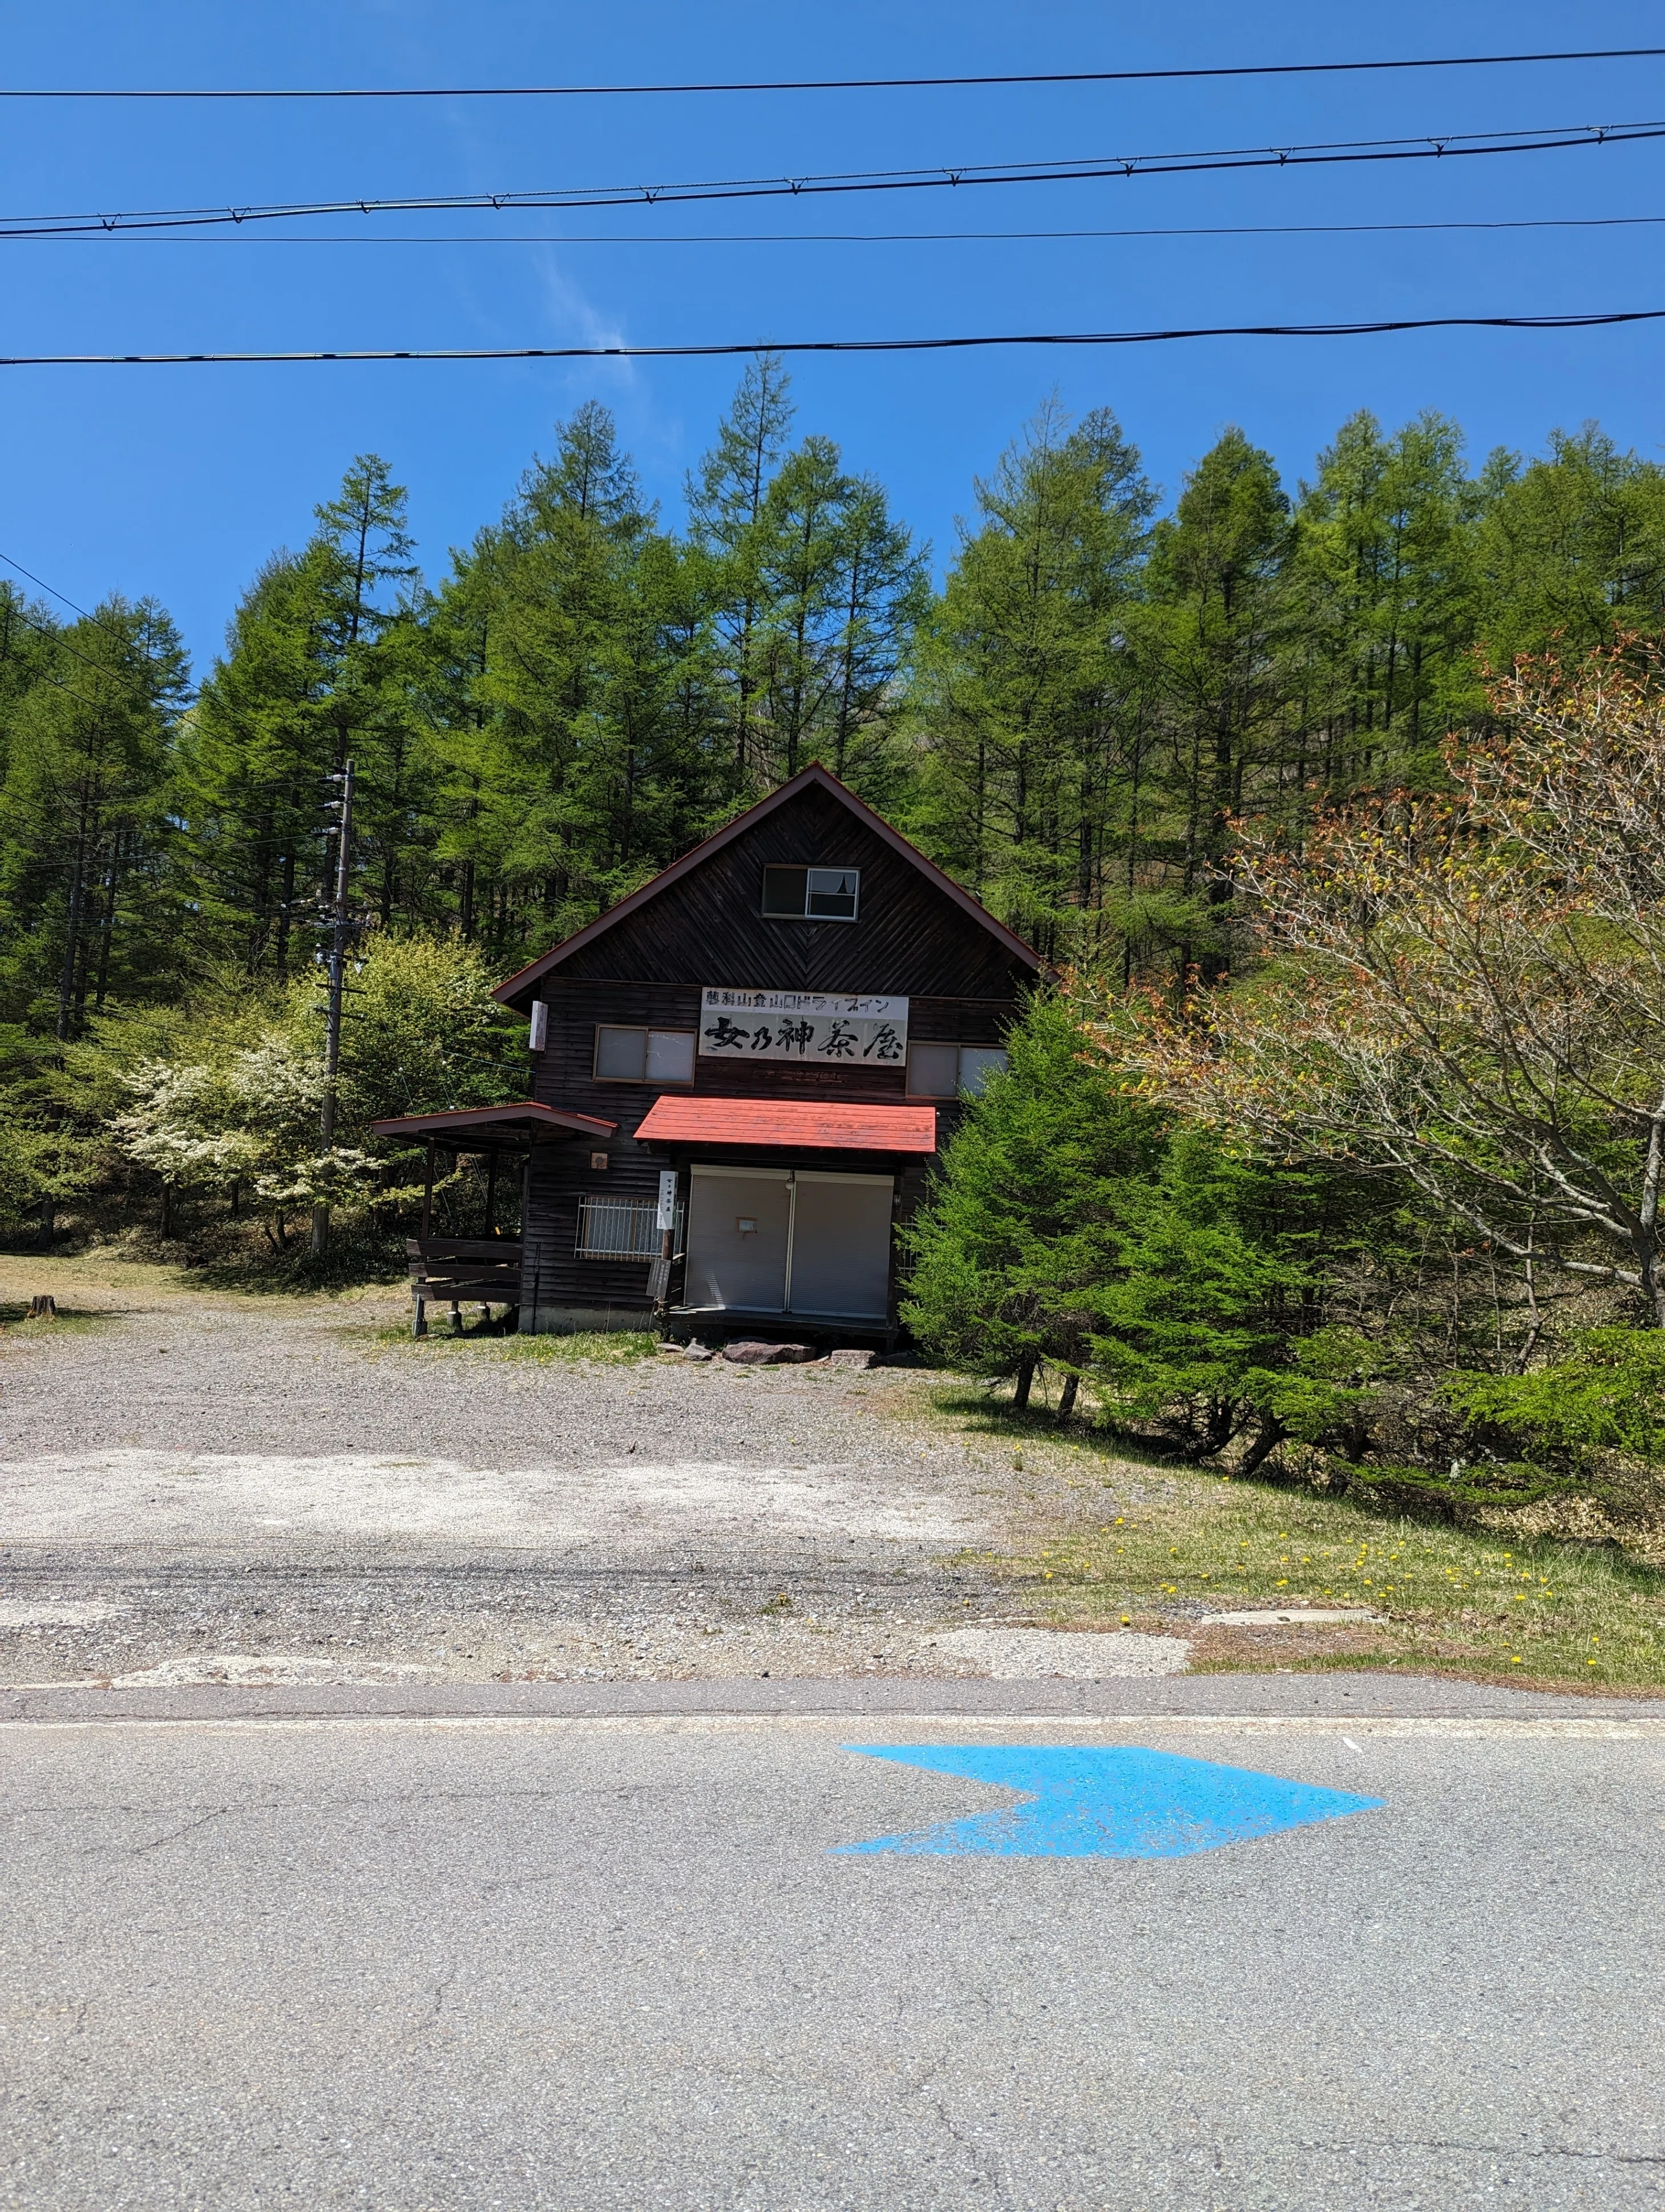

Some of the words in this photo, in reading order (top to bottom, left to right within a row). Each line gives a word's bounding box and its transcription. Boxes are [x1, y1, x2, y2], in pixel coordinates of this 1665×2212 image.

[704, 1016, 904, 1060] 女乃神茶屋
